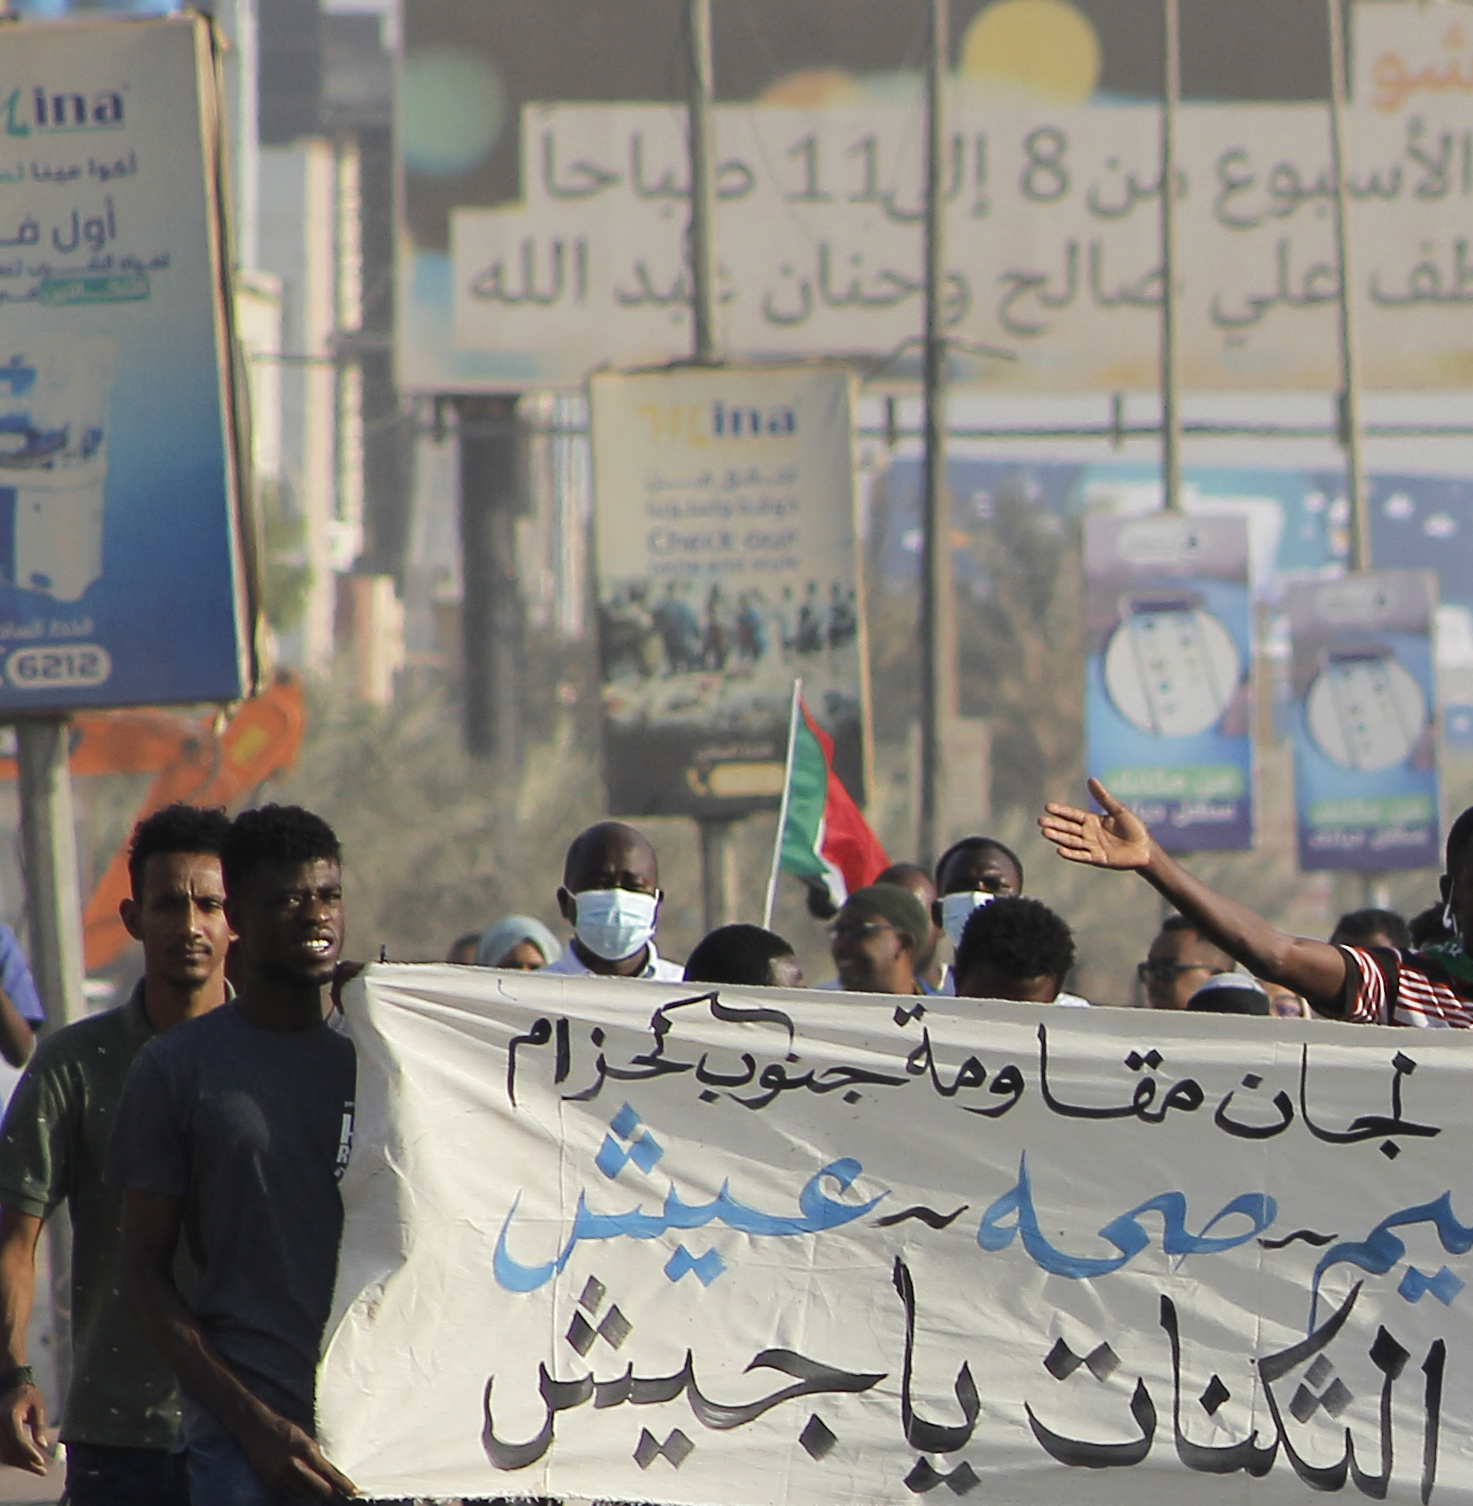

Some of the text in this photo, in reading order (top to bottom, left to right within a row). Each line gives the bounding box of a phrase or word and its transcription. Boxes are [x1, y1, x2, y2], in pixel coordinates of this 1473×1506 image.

[785, 136, 879, 203] 11
[1020, 128, 1071, 203] 8
[469, 238, 589, 308] الله
[1211, 238, 1345, 345] علي
[17, 653, 98, 682] 6212
[896, 1005, 1204, 1122] مقاومة
[1214, 1043, 1442, 1159] لجان
[491, 1102, 893, 1292] عيش
